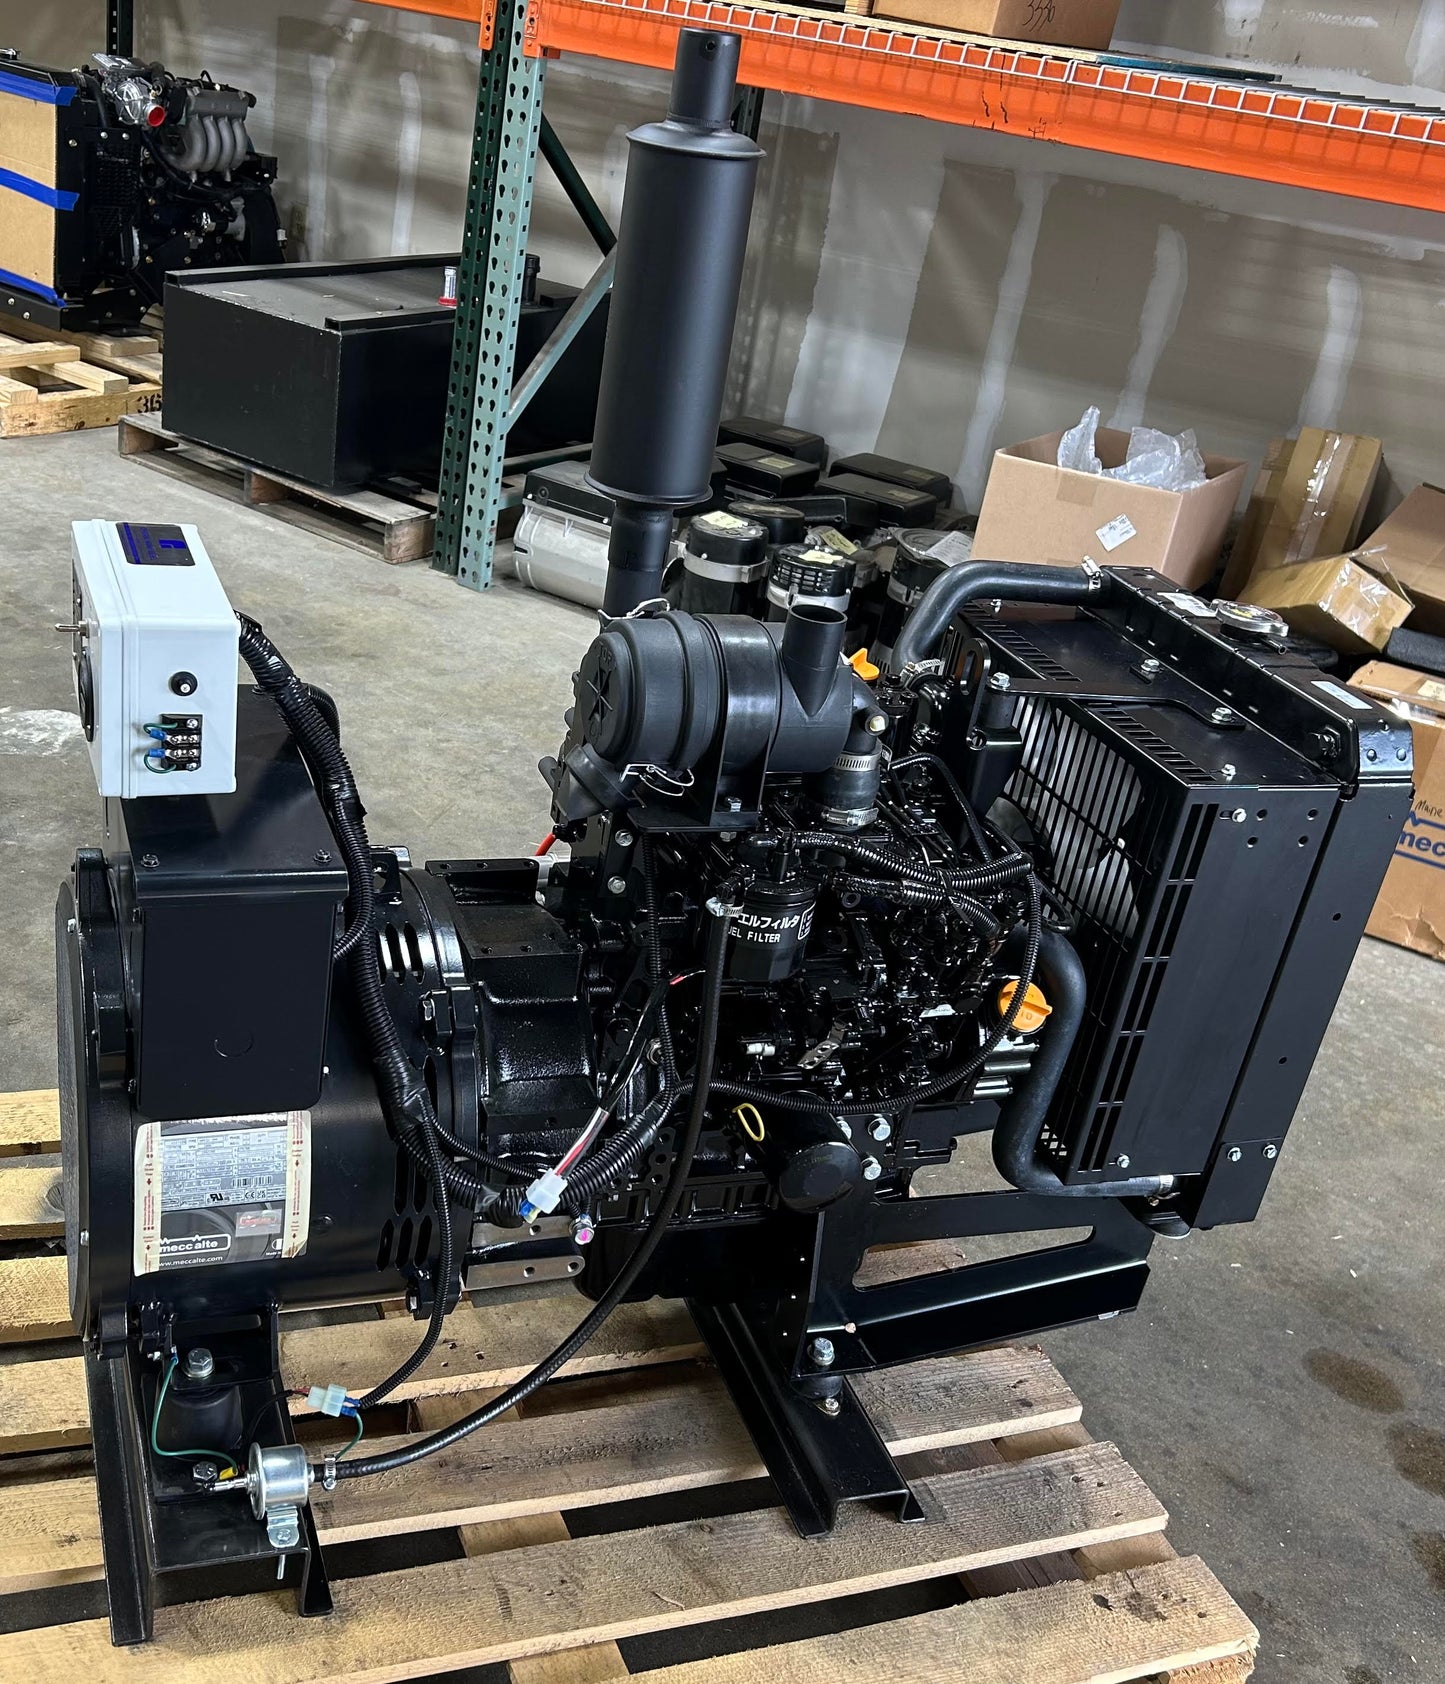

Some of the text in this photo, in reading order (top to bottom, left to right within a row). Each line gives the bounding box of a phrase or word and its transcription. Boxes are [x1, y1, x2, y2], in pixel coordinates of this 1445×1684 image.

[738, 912, 801, 930] エルフィルタ
[728, 926, 781, 943] UEL FILTER
[159, 1256, 223, 1266] ww.meccalte.com
